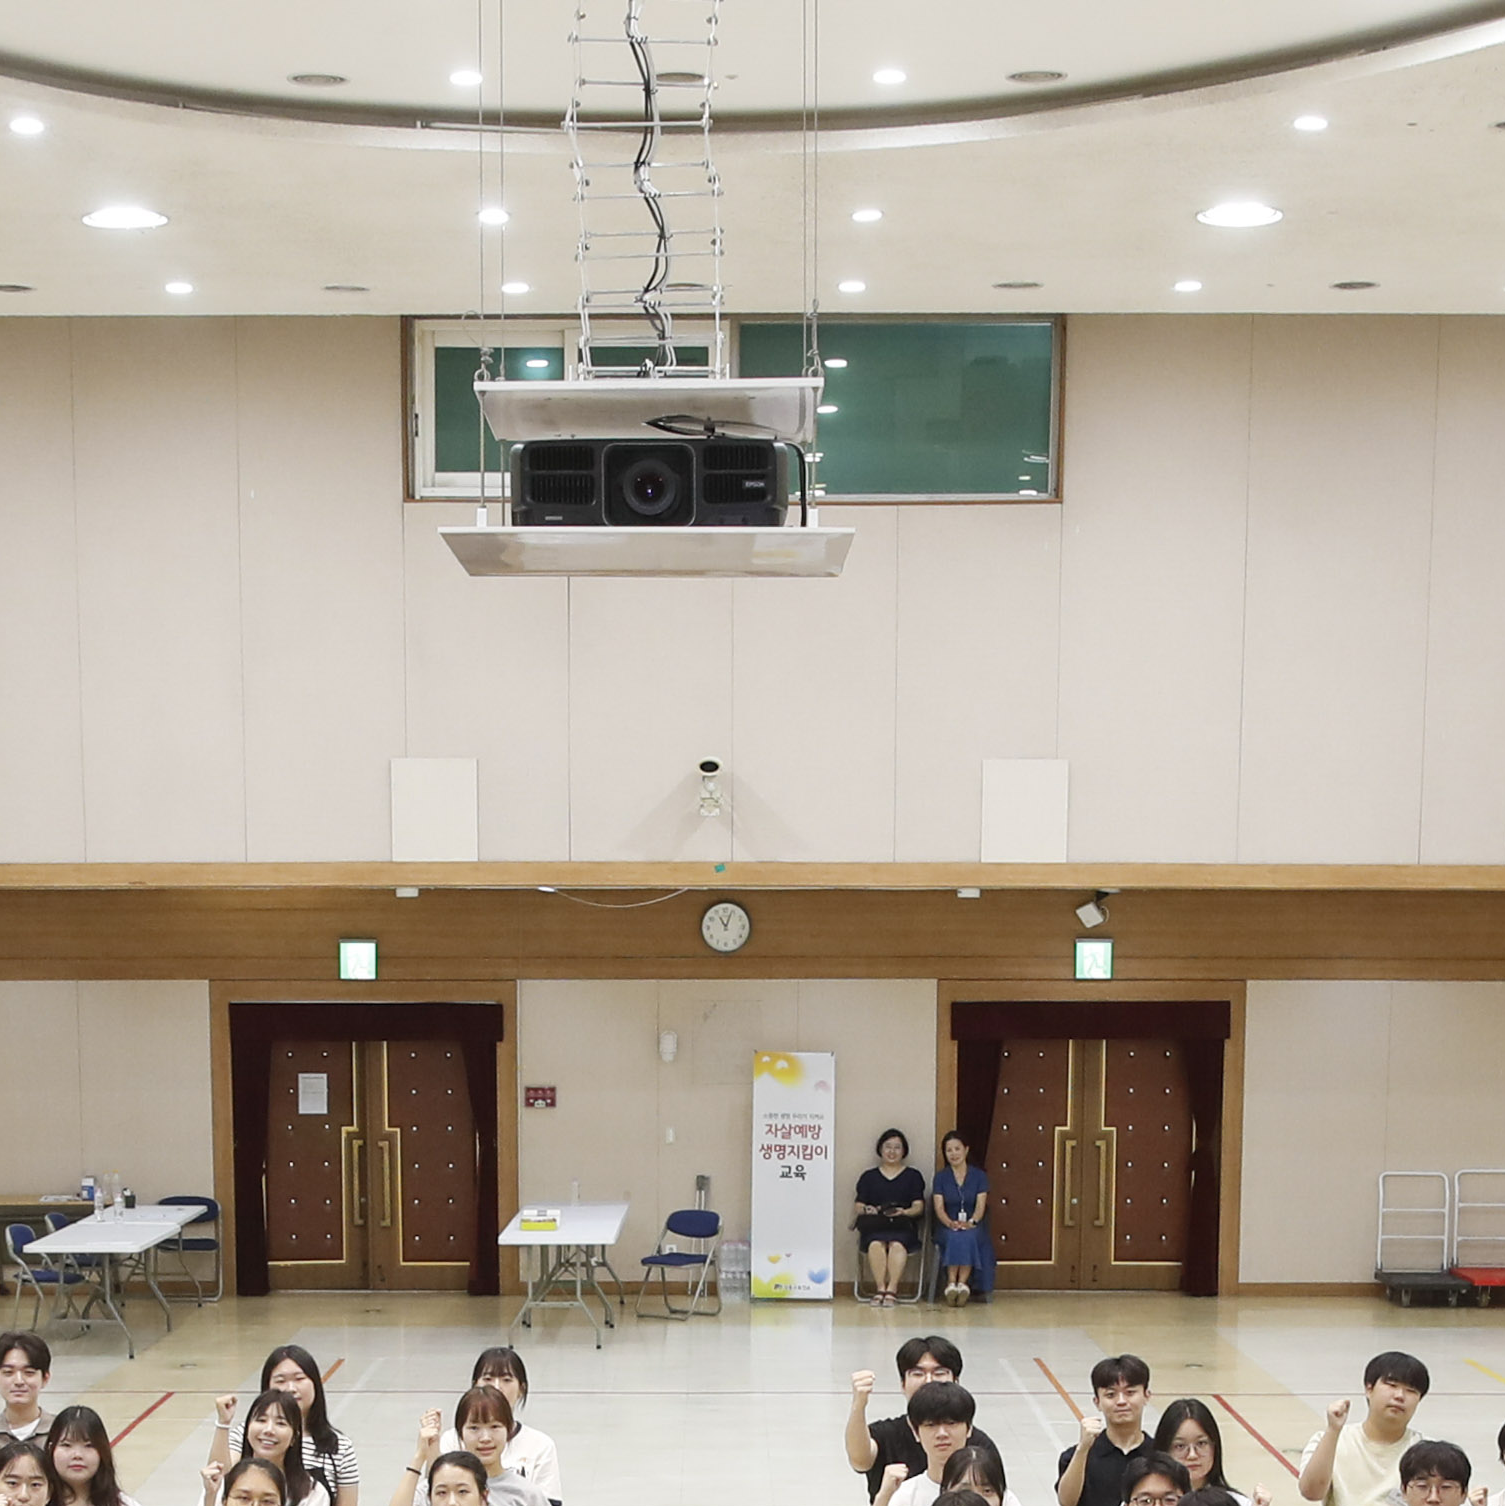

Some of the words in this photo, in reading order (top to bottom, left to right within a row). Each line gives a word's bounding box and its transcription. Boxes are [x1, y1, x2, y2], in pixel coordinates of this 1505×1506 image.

[765, 1123, 822, 1140] 자살예방
[759, 1144, 828, 1161] 생명지킴이
[779, 1164, 806, 1181] 교육
